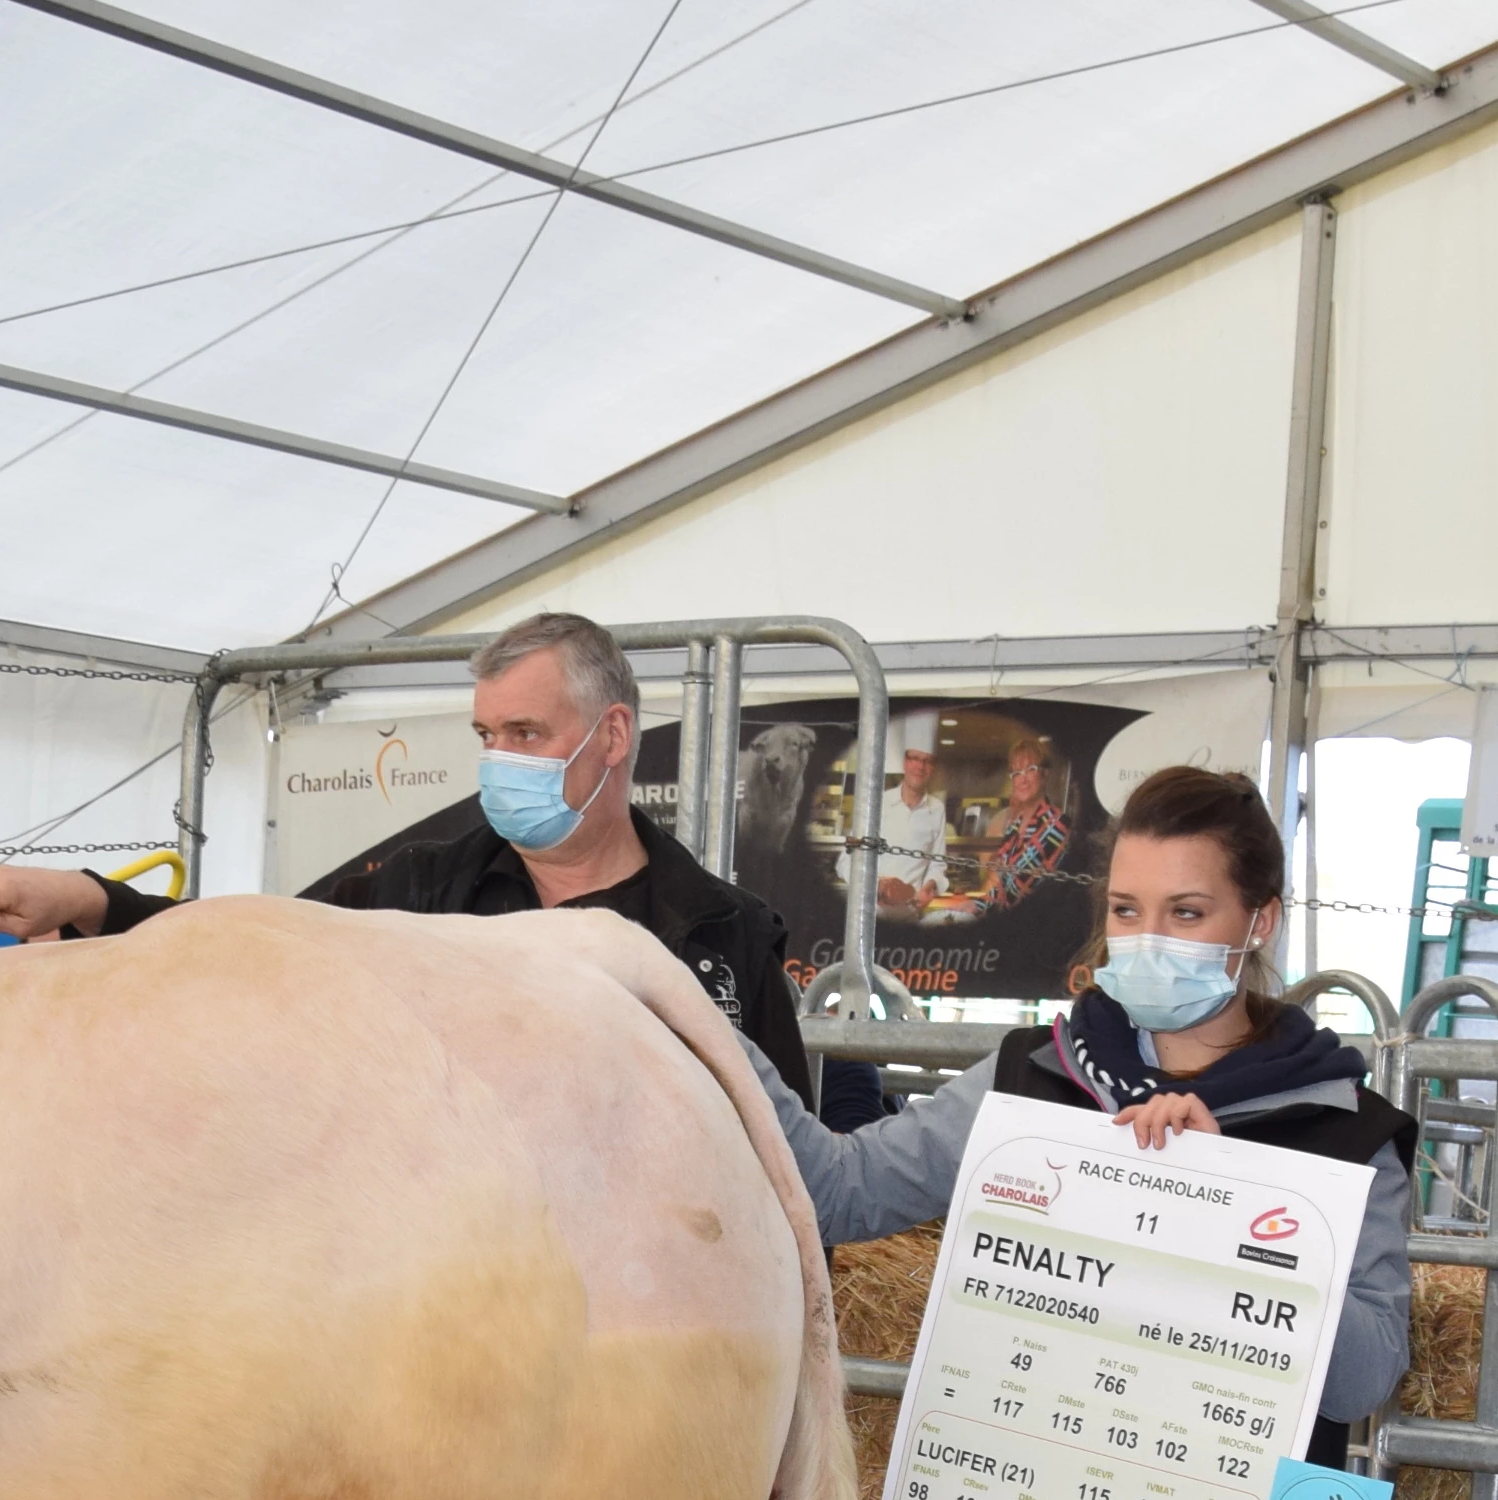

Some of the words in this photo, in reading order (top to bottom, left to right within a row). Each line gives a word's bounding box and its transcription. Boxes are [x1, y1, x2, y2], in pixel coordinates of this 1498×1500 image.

[287, 769, 372, 794] Charolais
[392, 768, 448, 786] France
[982, 1183, 1049, 1207] CHAROLAIS
[994, 1173, 1014, 1185] HERD
[1016, 1176, 1037, 1190] BOOK
[1079, 1161, 1125, 1183] RACE
[1129, 1172, 1234, 1206] CHAROLAISE
[1136, 1212, 1159, 1234] 11
[973, 1232, 1115, 1288] PENALTY
[1231, 1292, 1297, 1332] RJR
[964, 1277, 989, 1298] FR
[995, 1284, 1099, 1324] 7122020540
[1139, 1323, 1161, 1340] né
[1167, 1327, 1183, 1345] le
[1189, 1332, 1291, 1371] 25/11/2019
[1024, 1337, 1047, 1352] Naiss
[1100, 1358, 1118, 1370] PAT
[1120, 1363, 1138, 1376] 430j
[1192, 1381, 1214, 1394] GMQ
[1217, 1389, 1250, 1402] nais-fin
[1253, 1398, 1276, 1409] contr
[941, 1365, 970, 1379] IFNAIS
[1001, 1380, 1027, 1393] CRste
[1058, 1395, 1085, 1408] DMste
[1113, 1409, 1138, 1422] DSste
[1161, 1422, 1188, 1435] AFste
[1218, 1436, 1264, 1455] IMOCRste
[1011, 1353, 1032, 1371] 49
[1094, 1372, 1126, 1395] 766
[1202, 1402, 1246, 1427] 1665
[1249, 1416, 1275, 1439] g/j
[922, 1422, 940, 1434] Père
[993, 1397, 1024, 1418] 117
[1052, 1412, 1083, 1434] 115
[1107, 1427, 1138, 1449] 103
[1156, 1439, 1188, 1462] 102
[1218, 1455, 1250, 1478] 122
[913, 1464, 940, 1477] IFNAIS
[964, 1478, 989, 1491] CRsev
[917, 1440, 996, 1476] LUCIFER
[1001, 1462, 1035, 1489] (21)
[1086, 1466, 1114, 1480] ISEVR
[1147, 1482, 1175, 1497] IVMAT
[908, 1482, 929, 1500] 98
